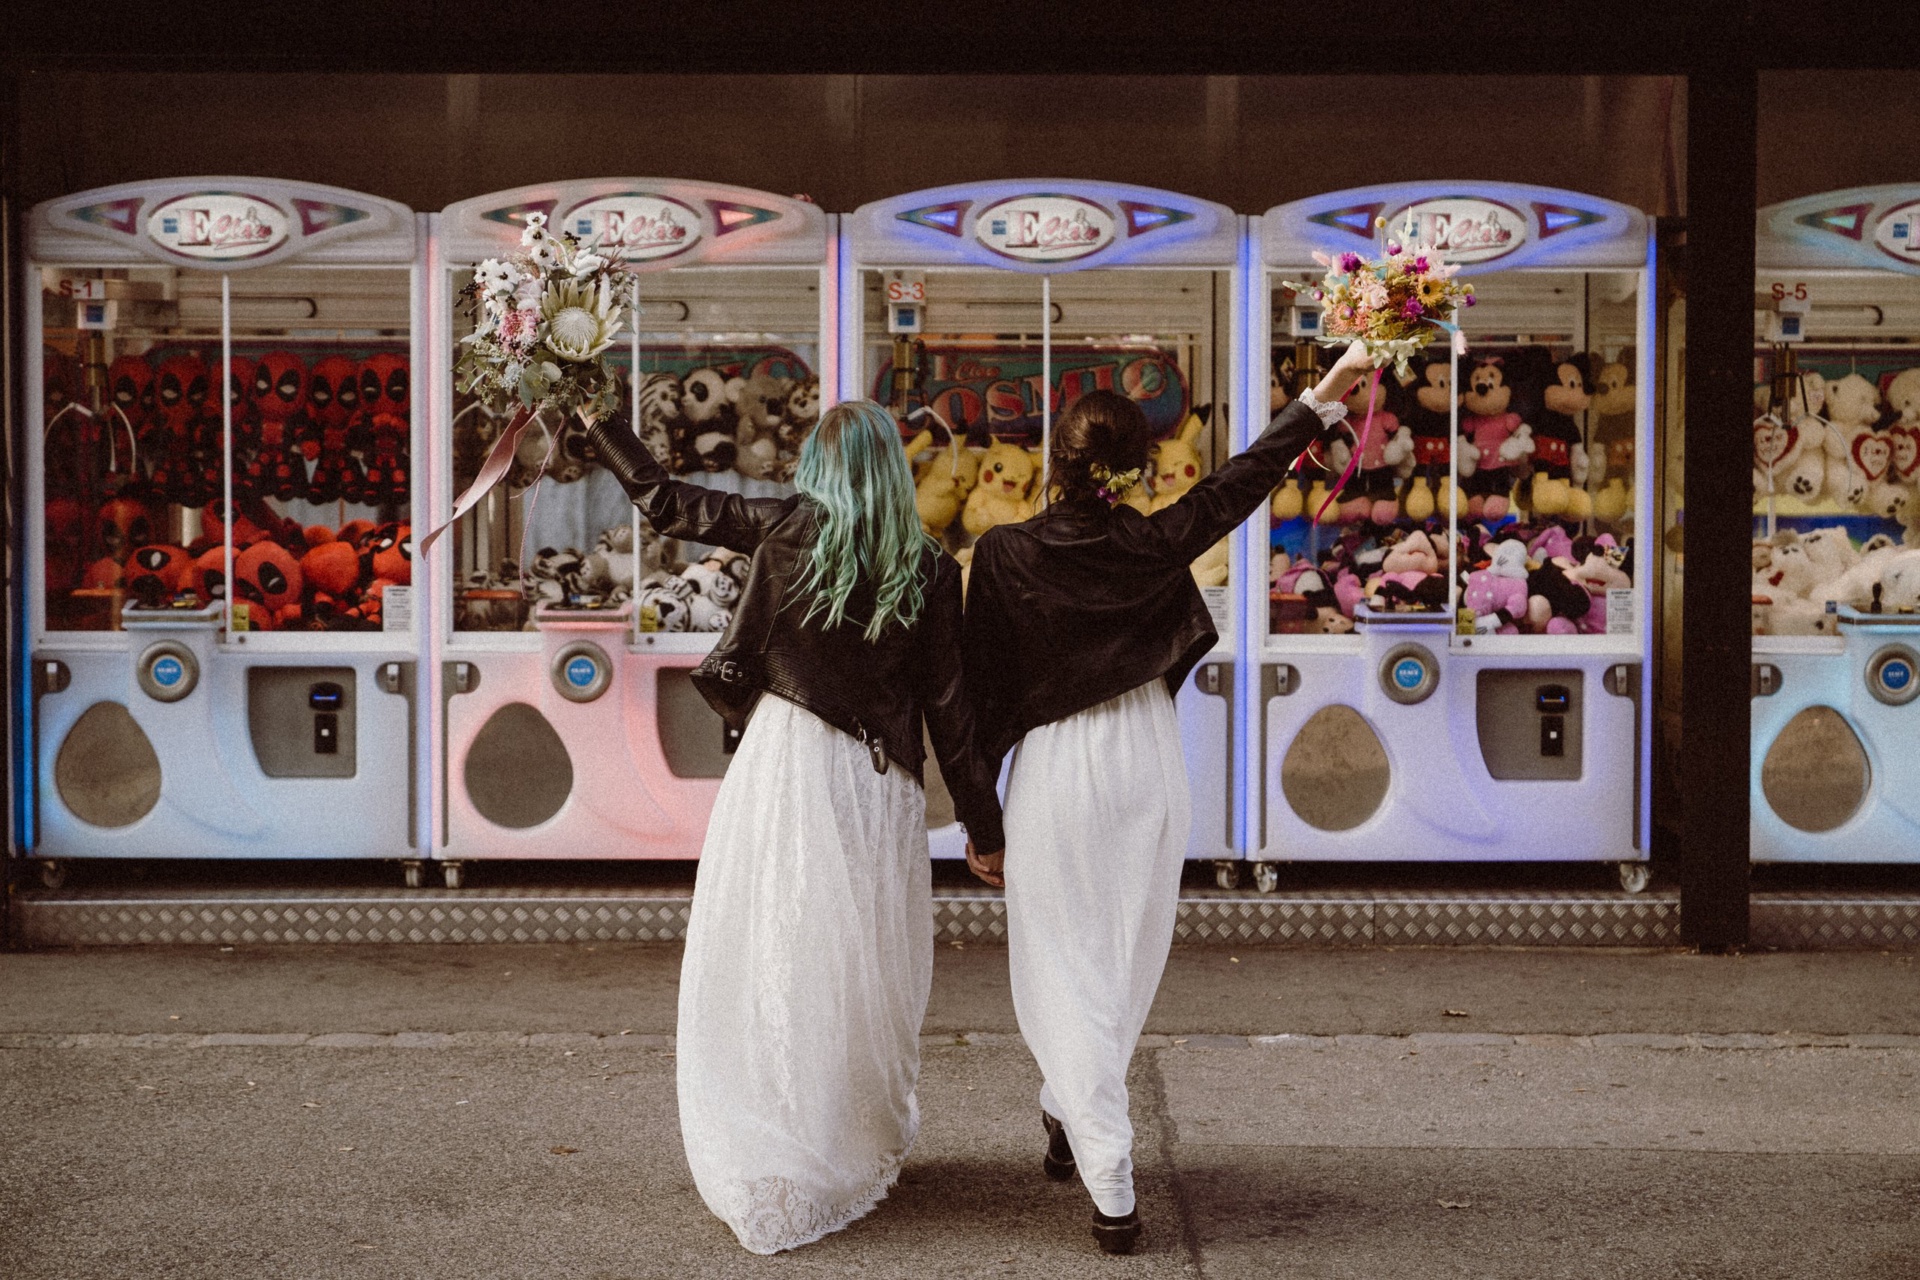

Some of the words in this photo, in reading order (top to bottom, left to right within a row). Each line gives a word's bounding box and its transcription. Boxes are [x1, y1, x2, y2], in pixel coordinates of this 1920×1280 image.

[177, 209, 211, 246] E
[1004, 210, 1040, 248] E
[59, 279, 92, 297] S-1
[887, 282, 925, 300] S-3
[1771, 282, 1808, 301] S-5
